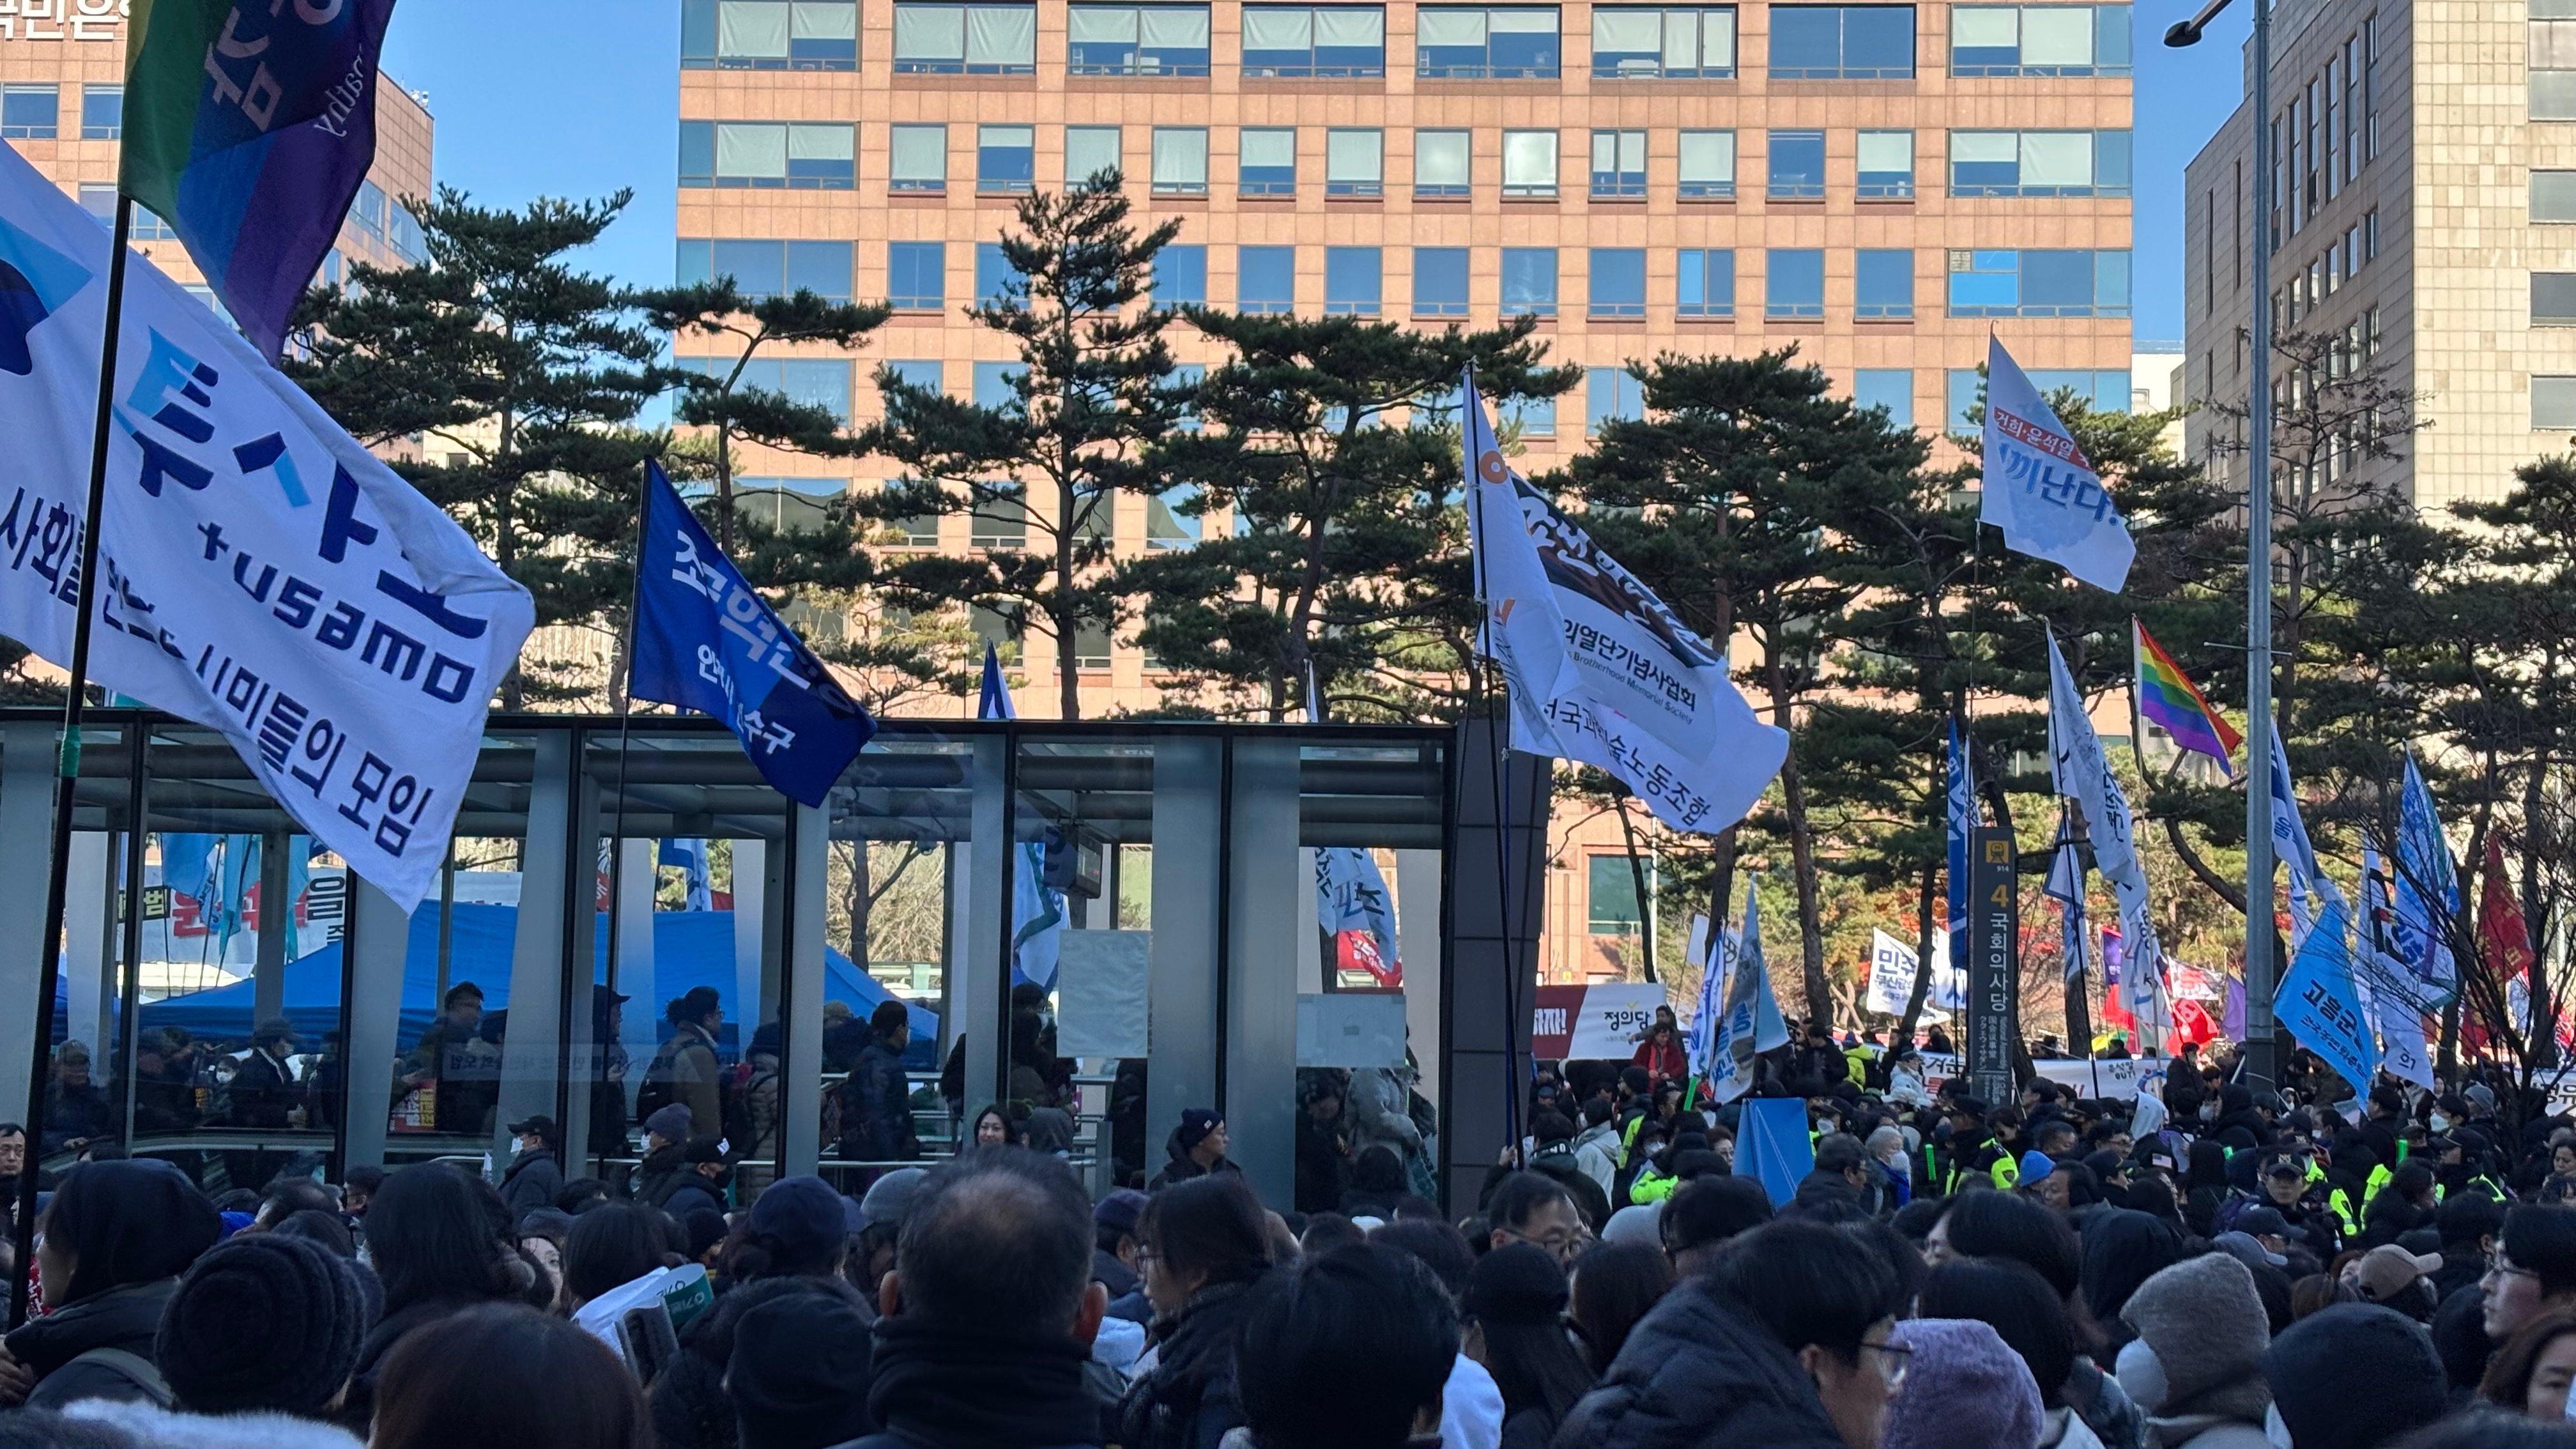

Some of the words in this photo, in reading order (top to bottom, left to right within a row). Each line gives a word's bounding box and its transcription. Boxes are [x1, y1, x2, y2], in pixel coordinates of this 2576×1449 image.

[0, 0, 129, 40] 민은
[197, 521, 476, 704] tusamo
[1573, 652, 1626, 684] Brotherhood
[1627, 677, 1665, 705] Memorial
[1664, 703, 1694, 726] Society
[339, 751, 434, 858] 모임
[1990, 884, 2009, 908] 4
[1989, 912, 2009, 1012] 국회의사당
[1604, 1010, 1651, 1032] 정의당
